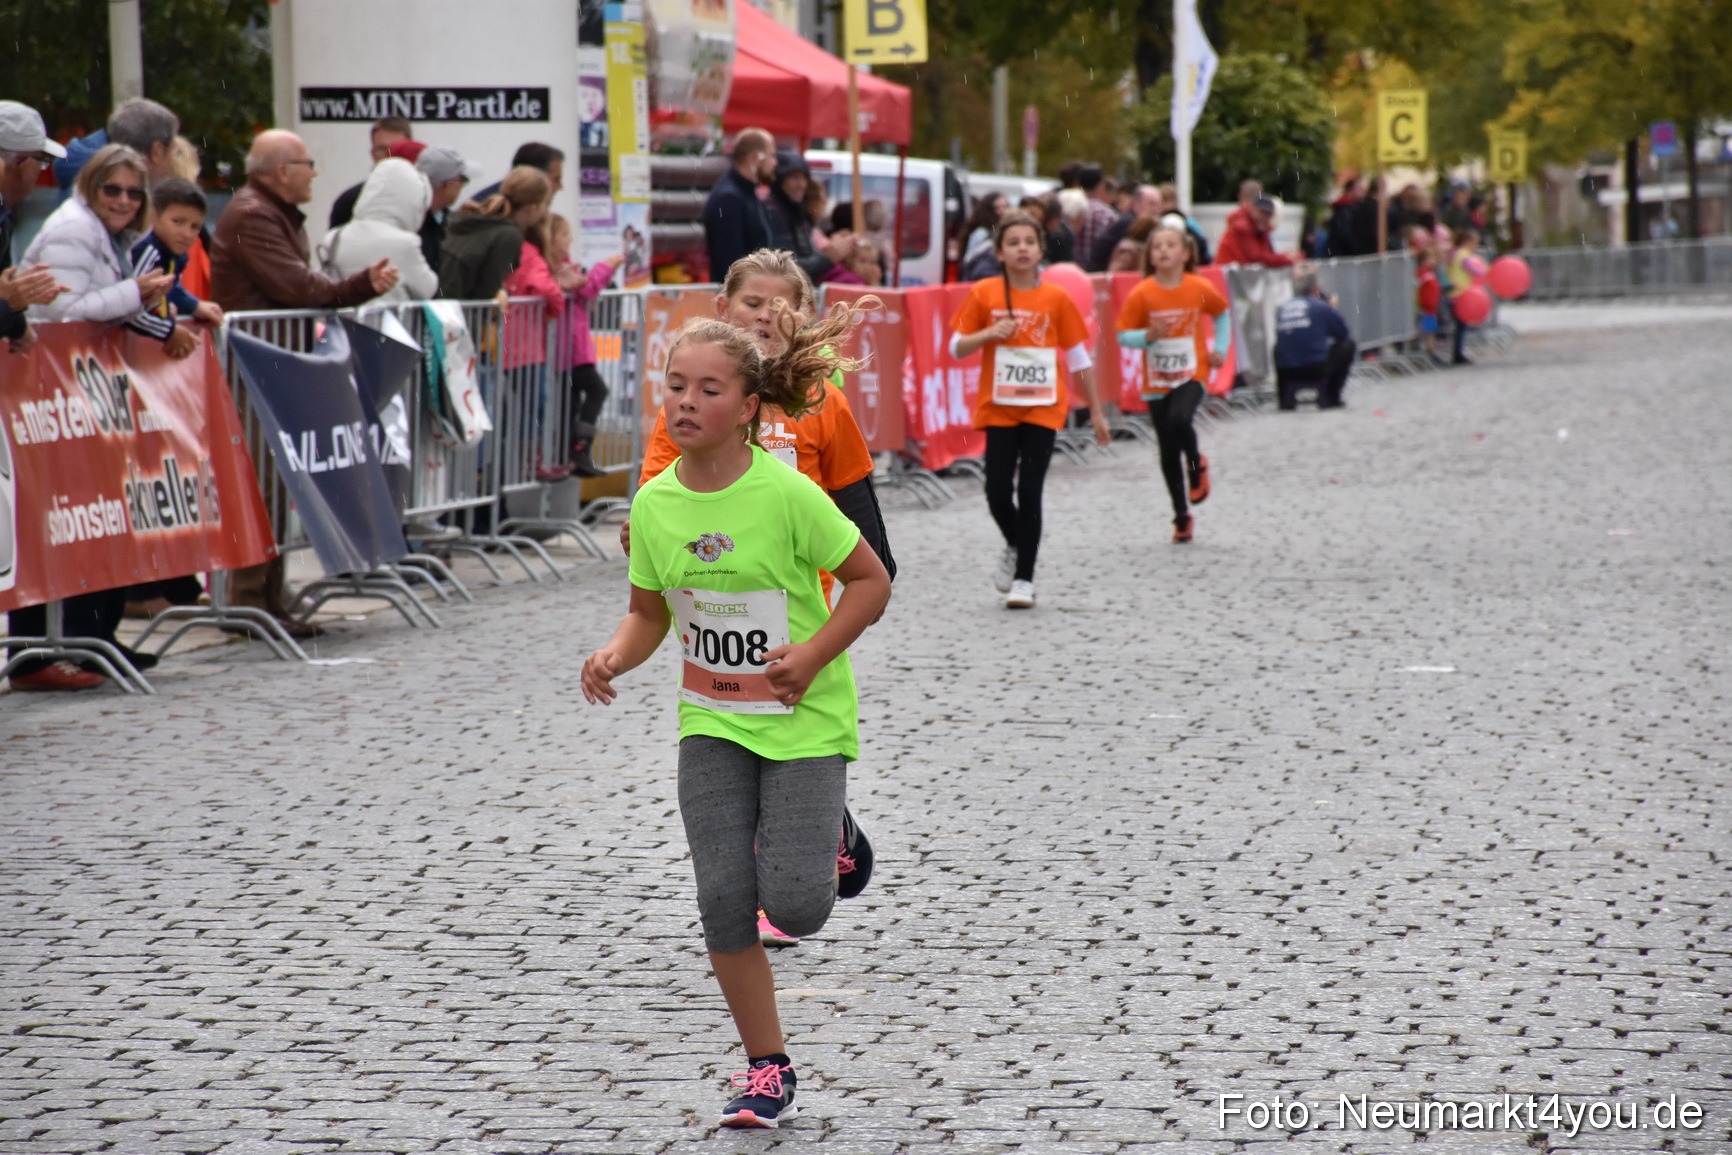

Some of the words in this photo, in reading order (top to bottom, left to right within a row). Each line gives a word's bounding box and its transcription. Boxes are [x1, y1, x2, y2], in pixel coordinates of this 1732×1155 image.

[866, 0, 905, 36] B
[301, 91, 542, 120] www.MINI-Partl.de
[1390, 112, 1414, 145] C
[1153, 353, 1188, 370] 7276
[1004, 364, 1047, 384] 7093
[704, 602, 748, 614] BOCK
[689, 621, 770, 666] 7008
[712, 678, 740, 692] Jana
